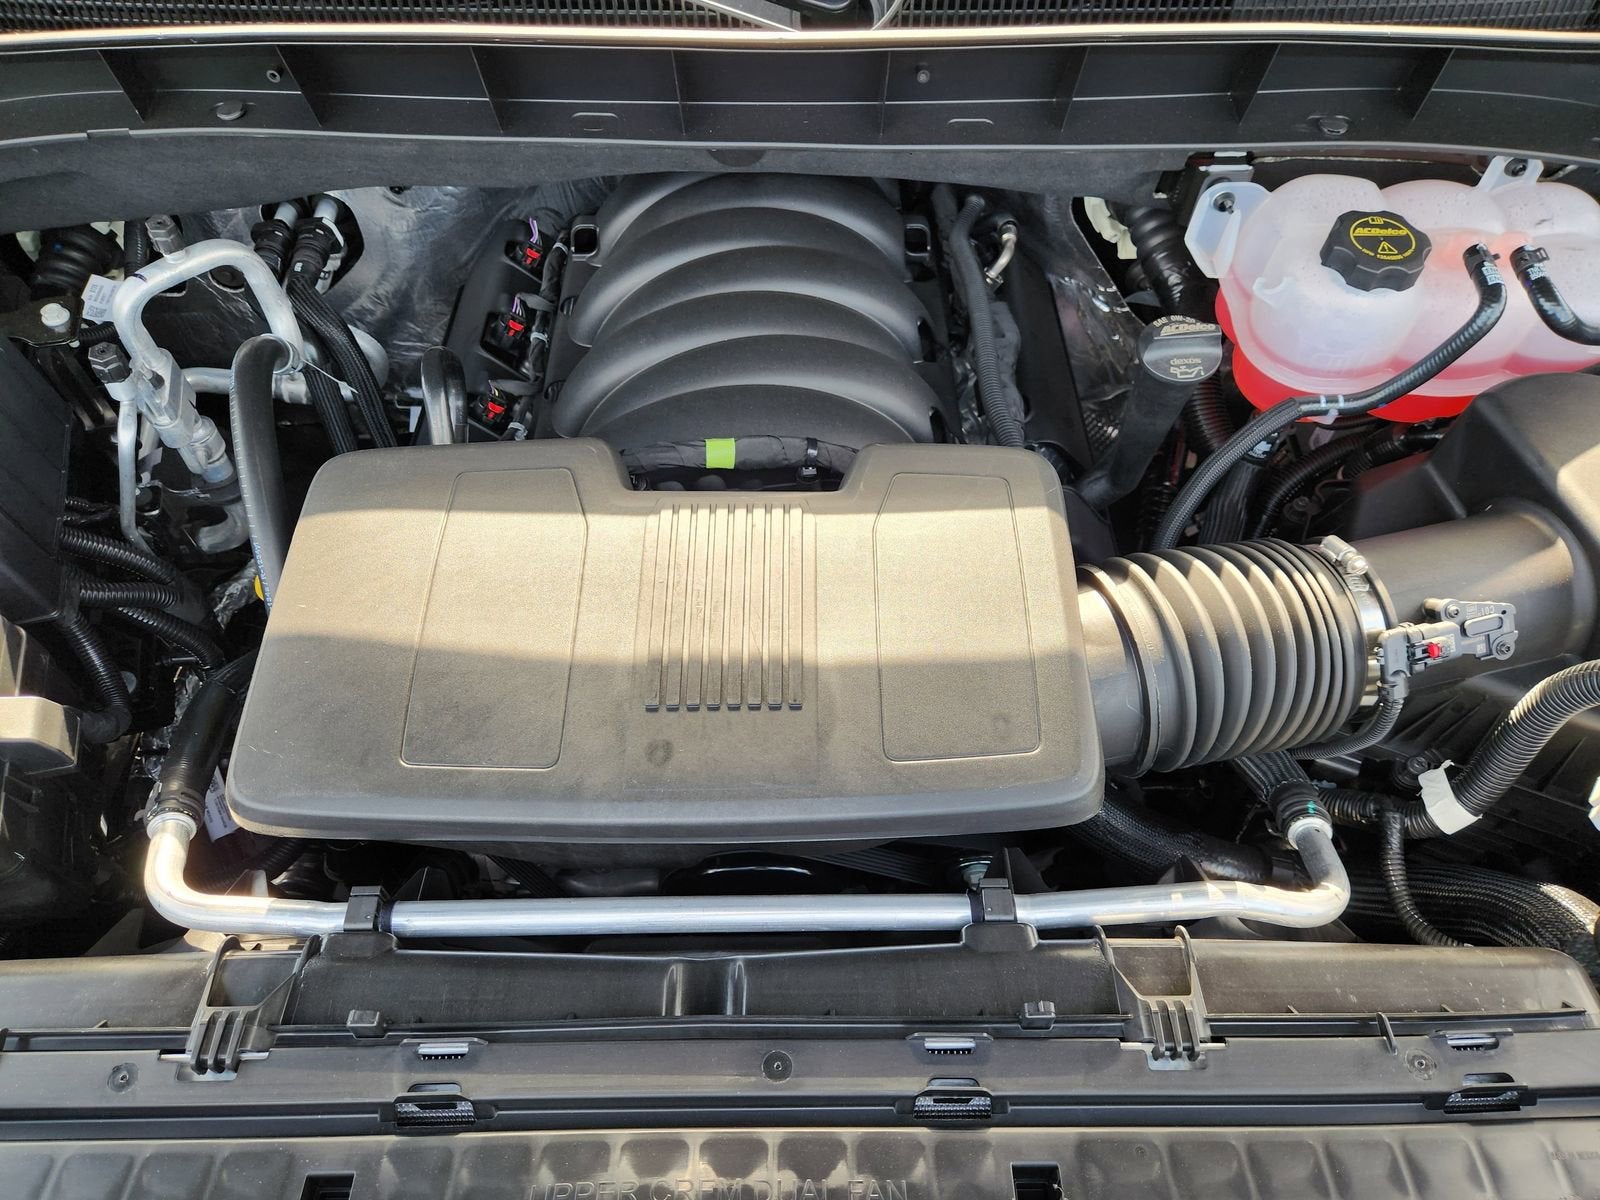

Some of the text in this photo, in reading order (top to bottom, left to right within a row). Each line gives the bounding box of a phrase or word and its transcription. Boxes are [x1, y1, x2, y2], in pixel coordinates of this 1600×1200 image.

[1353, 227, 1409, 236] ACDelco
[1152, 316, 1169, 328] SAE
[1160, 322, 1216, 336] ACDelco
[848, 1178, 908, 1200] FAN
